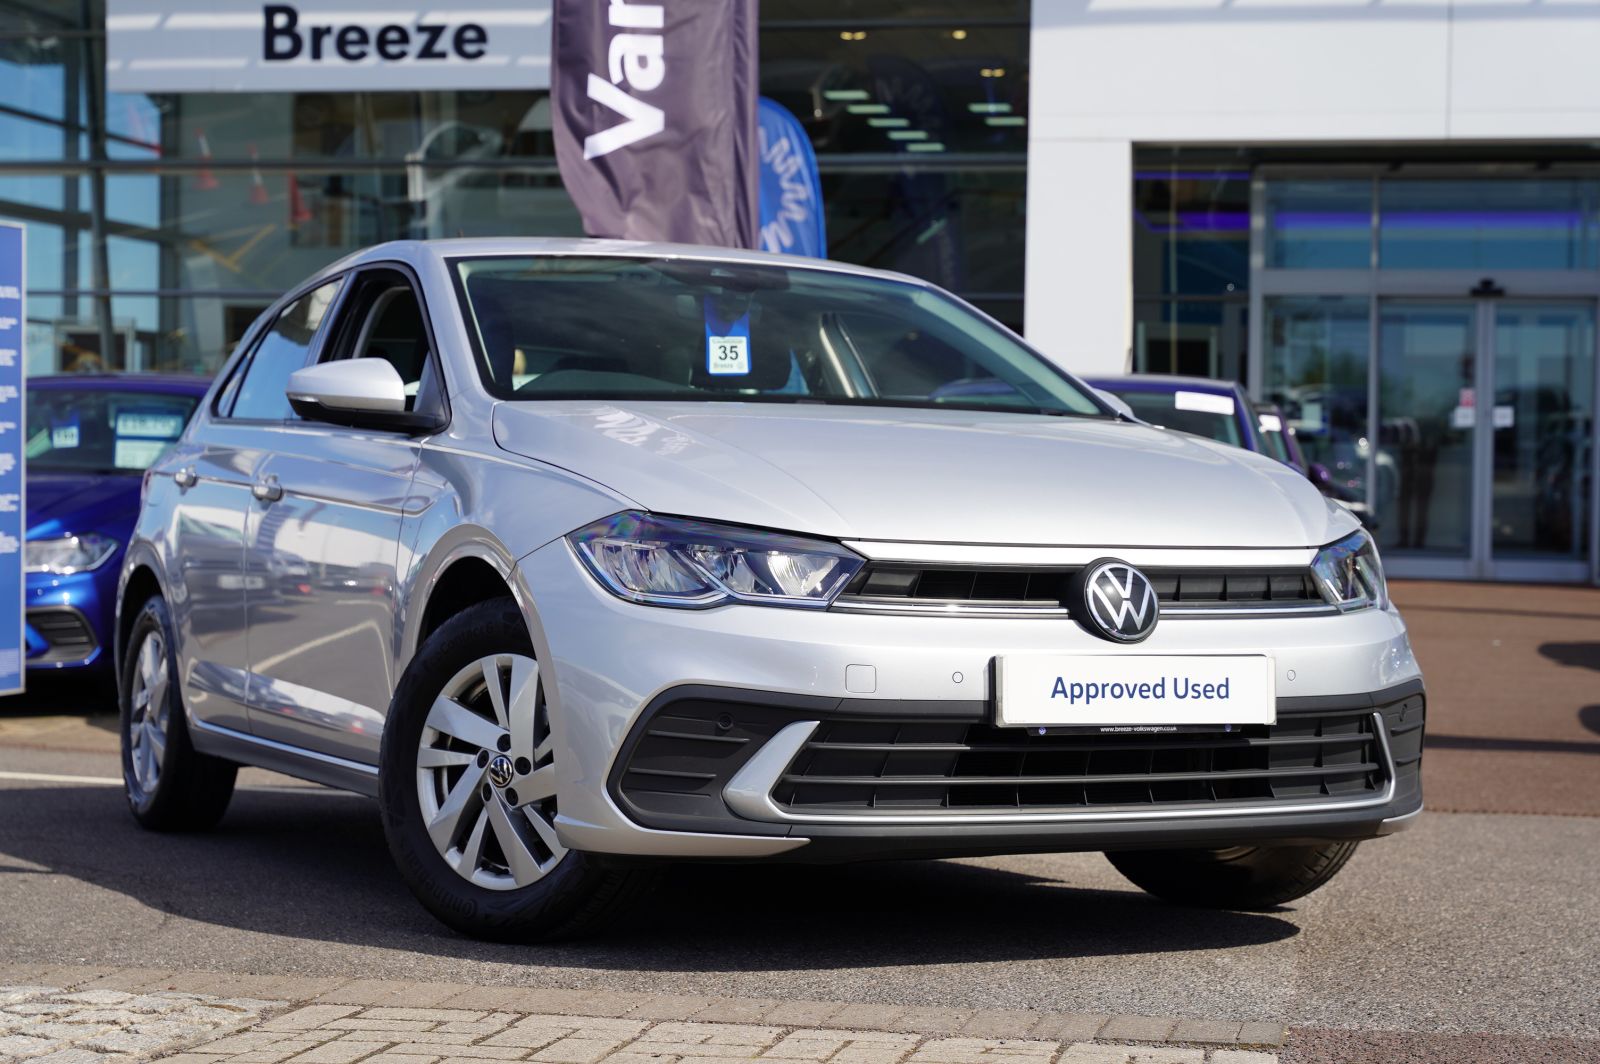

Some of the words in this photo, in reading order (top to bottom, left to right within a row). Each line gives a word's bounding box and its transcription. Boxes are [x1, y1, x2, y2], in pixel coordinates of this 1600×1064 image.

[263, 6, 488, 62] Breeze
[718, 345, 739, 360] 35
[1050, 676, 1166, 705] Approved
[1173, 676, 1230, 700] Used
